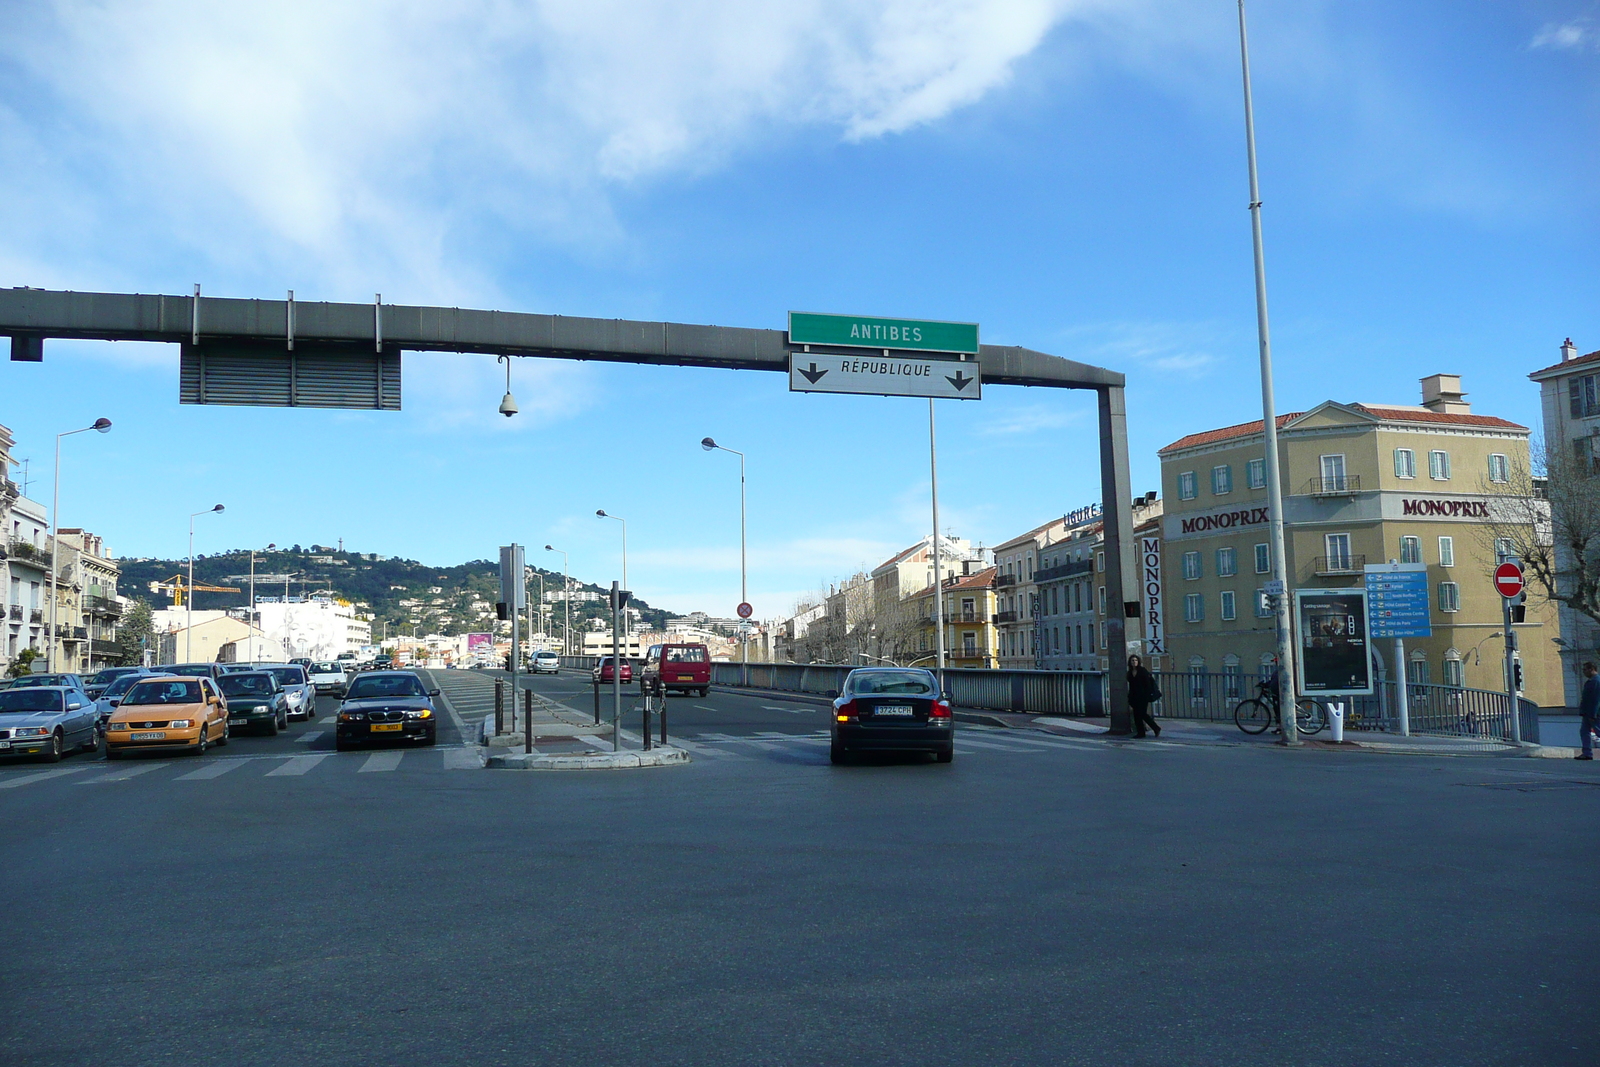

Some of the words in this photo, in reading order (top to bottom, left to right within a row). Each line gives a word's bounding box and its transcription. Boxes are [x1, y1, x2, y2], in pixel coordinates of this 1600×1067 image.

[850, 323, 923, 342] ANTIBES
[841, 358, 931, 377] RÉPUBLIQUE
[1402, 499, 1490, 518] MONOPRIX
[1181, 507, 1270, 534] MONOPRIX
[1143, 539, 1162, 654] MONOPRIX
[1033, 595, 1041, 637] HOTEL
[879, 705, 897, 714] 3724
[897, 705, 912, 714] CPH
